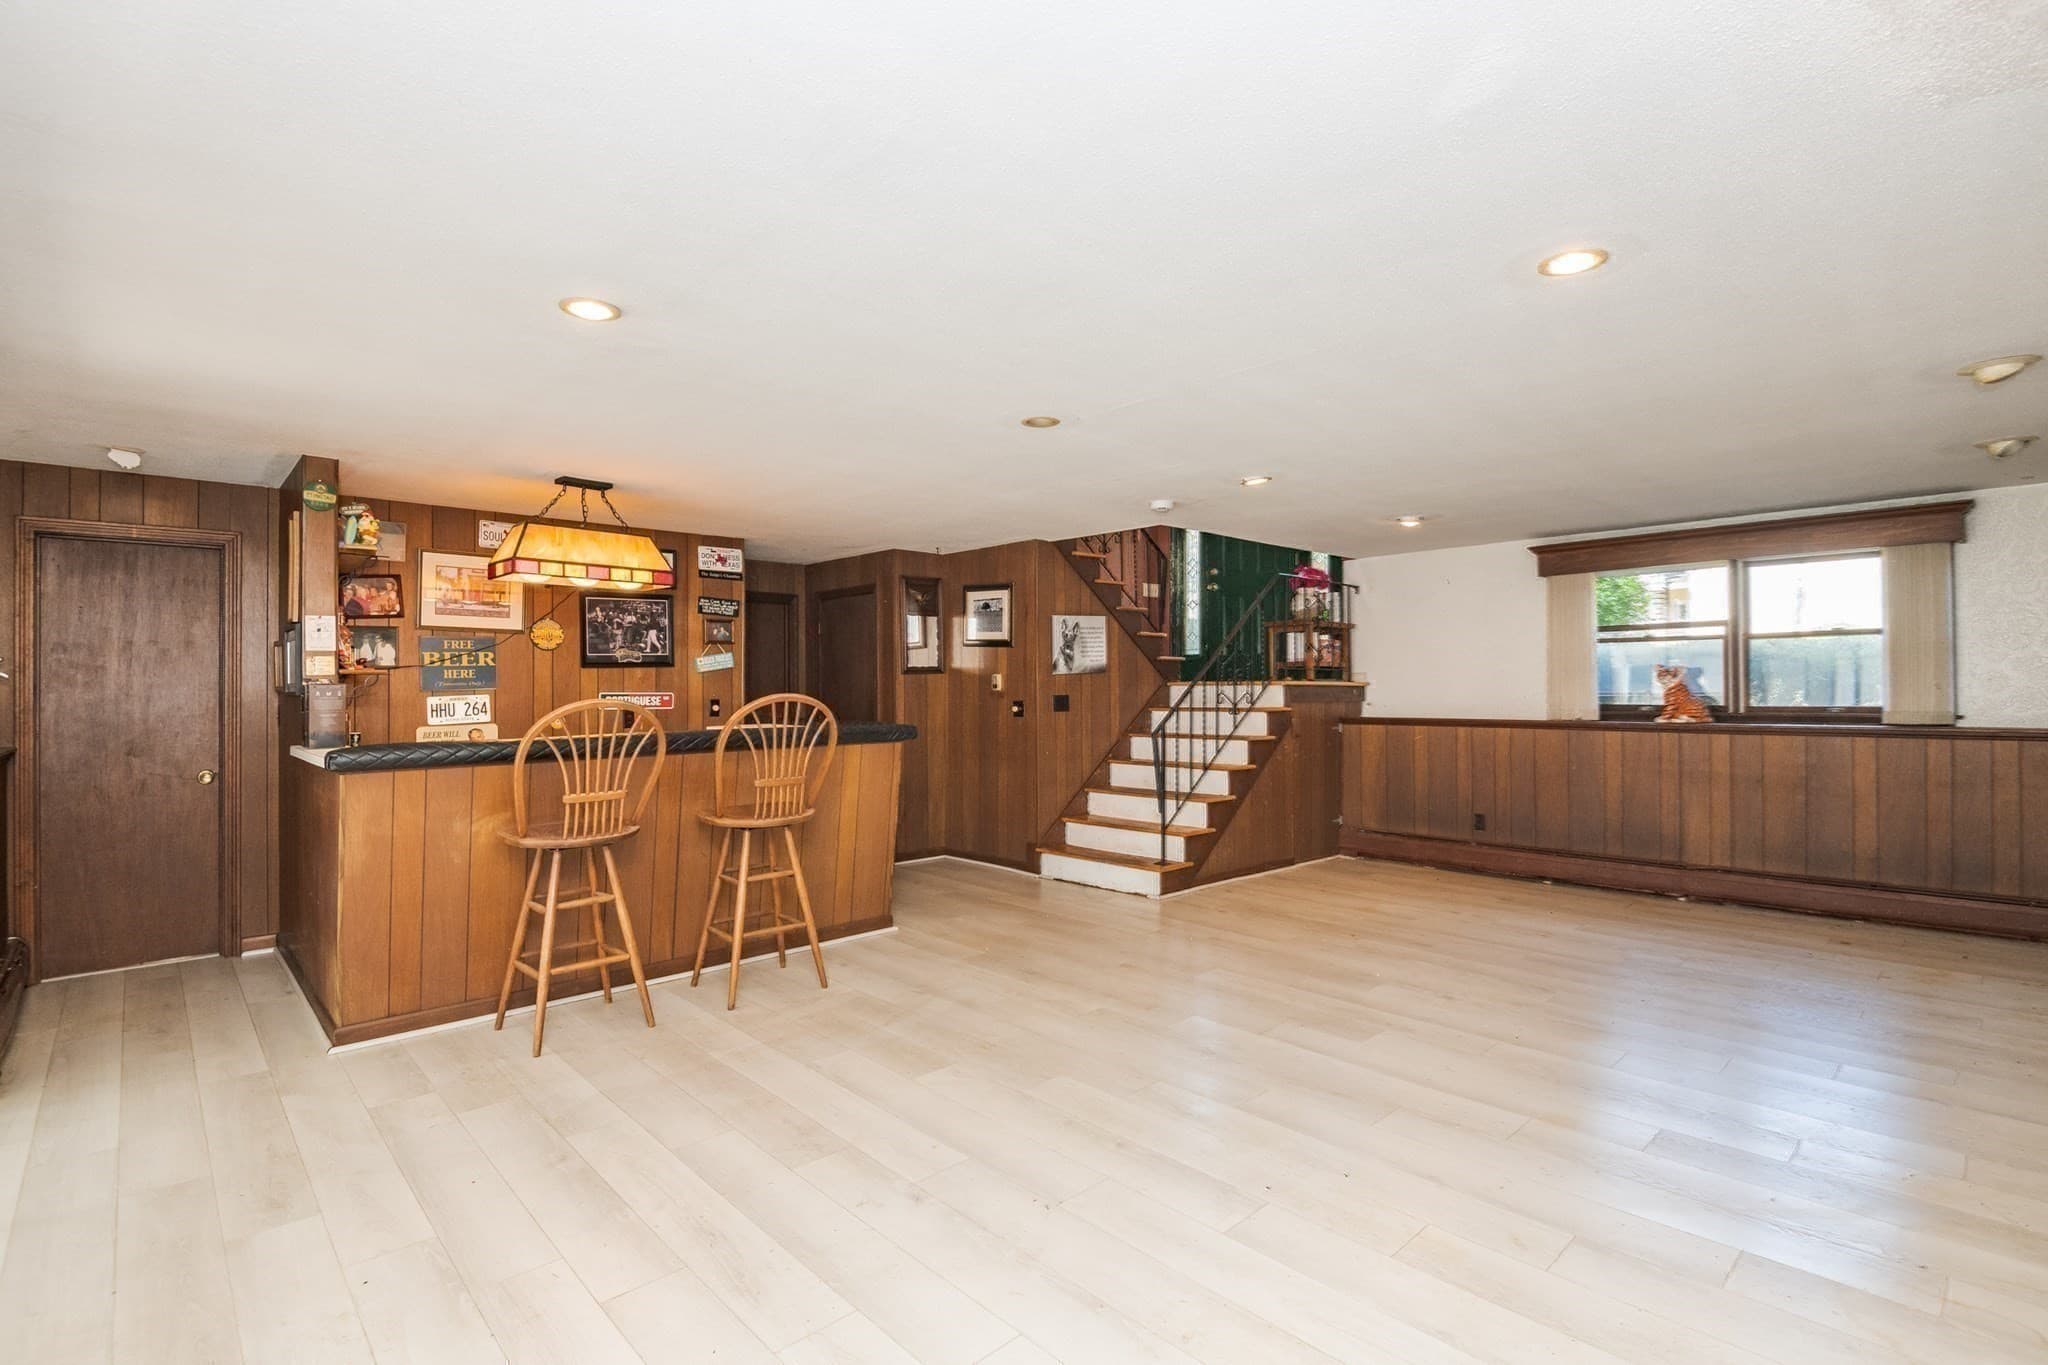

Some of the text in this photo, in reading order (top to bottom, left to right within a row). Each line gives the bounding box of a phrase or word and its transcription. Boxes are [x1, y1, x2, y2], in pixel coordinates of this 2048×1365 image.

[719, 561, 740, 569] EXAS
[443, 640, 475, 649] FREE
[422, 651, 496, 667] BEER
[444, 669, 476, 679] HERE
[430, 701, 488, 719] HHU 264
[423, 730, 461, 739] BEER WILL
